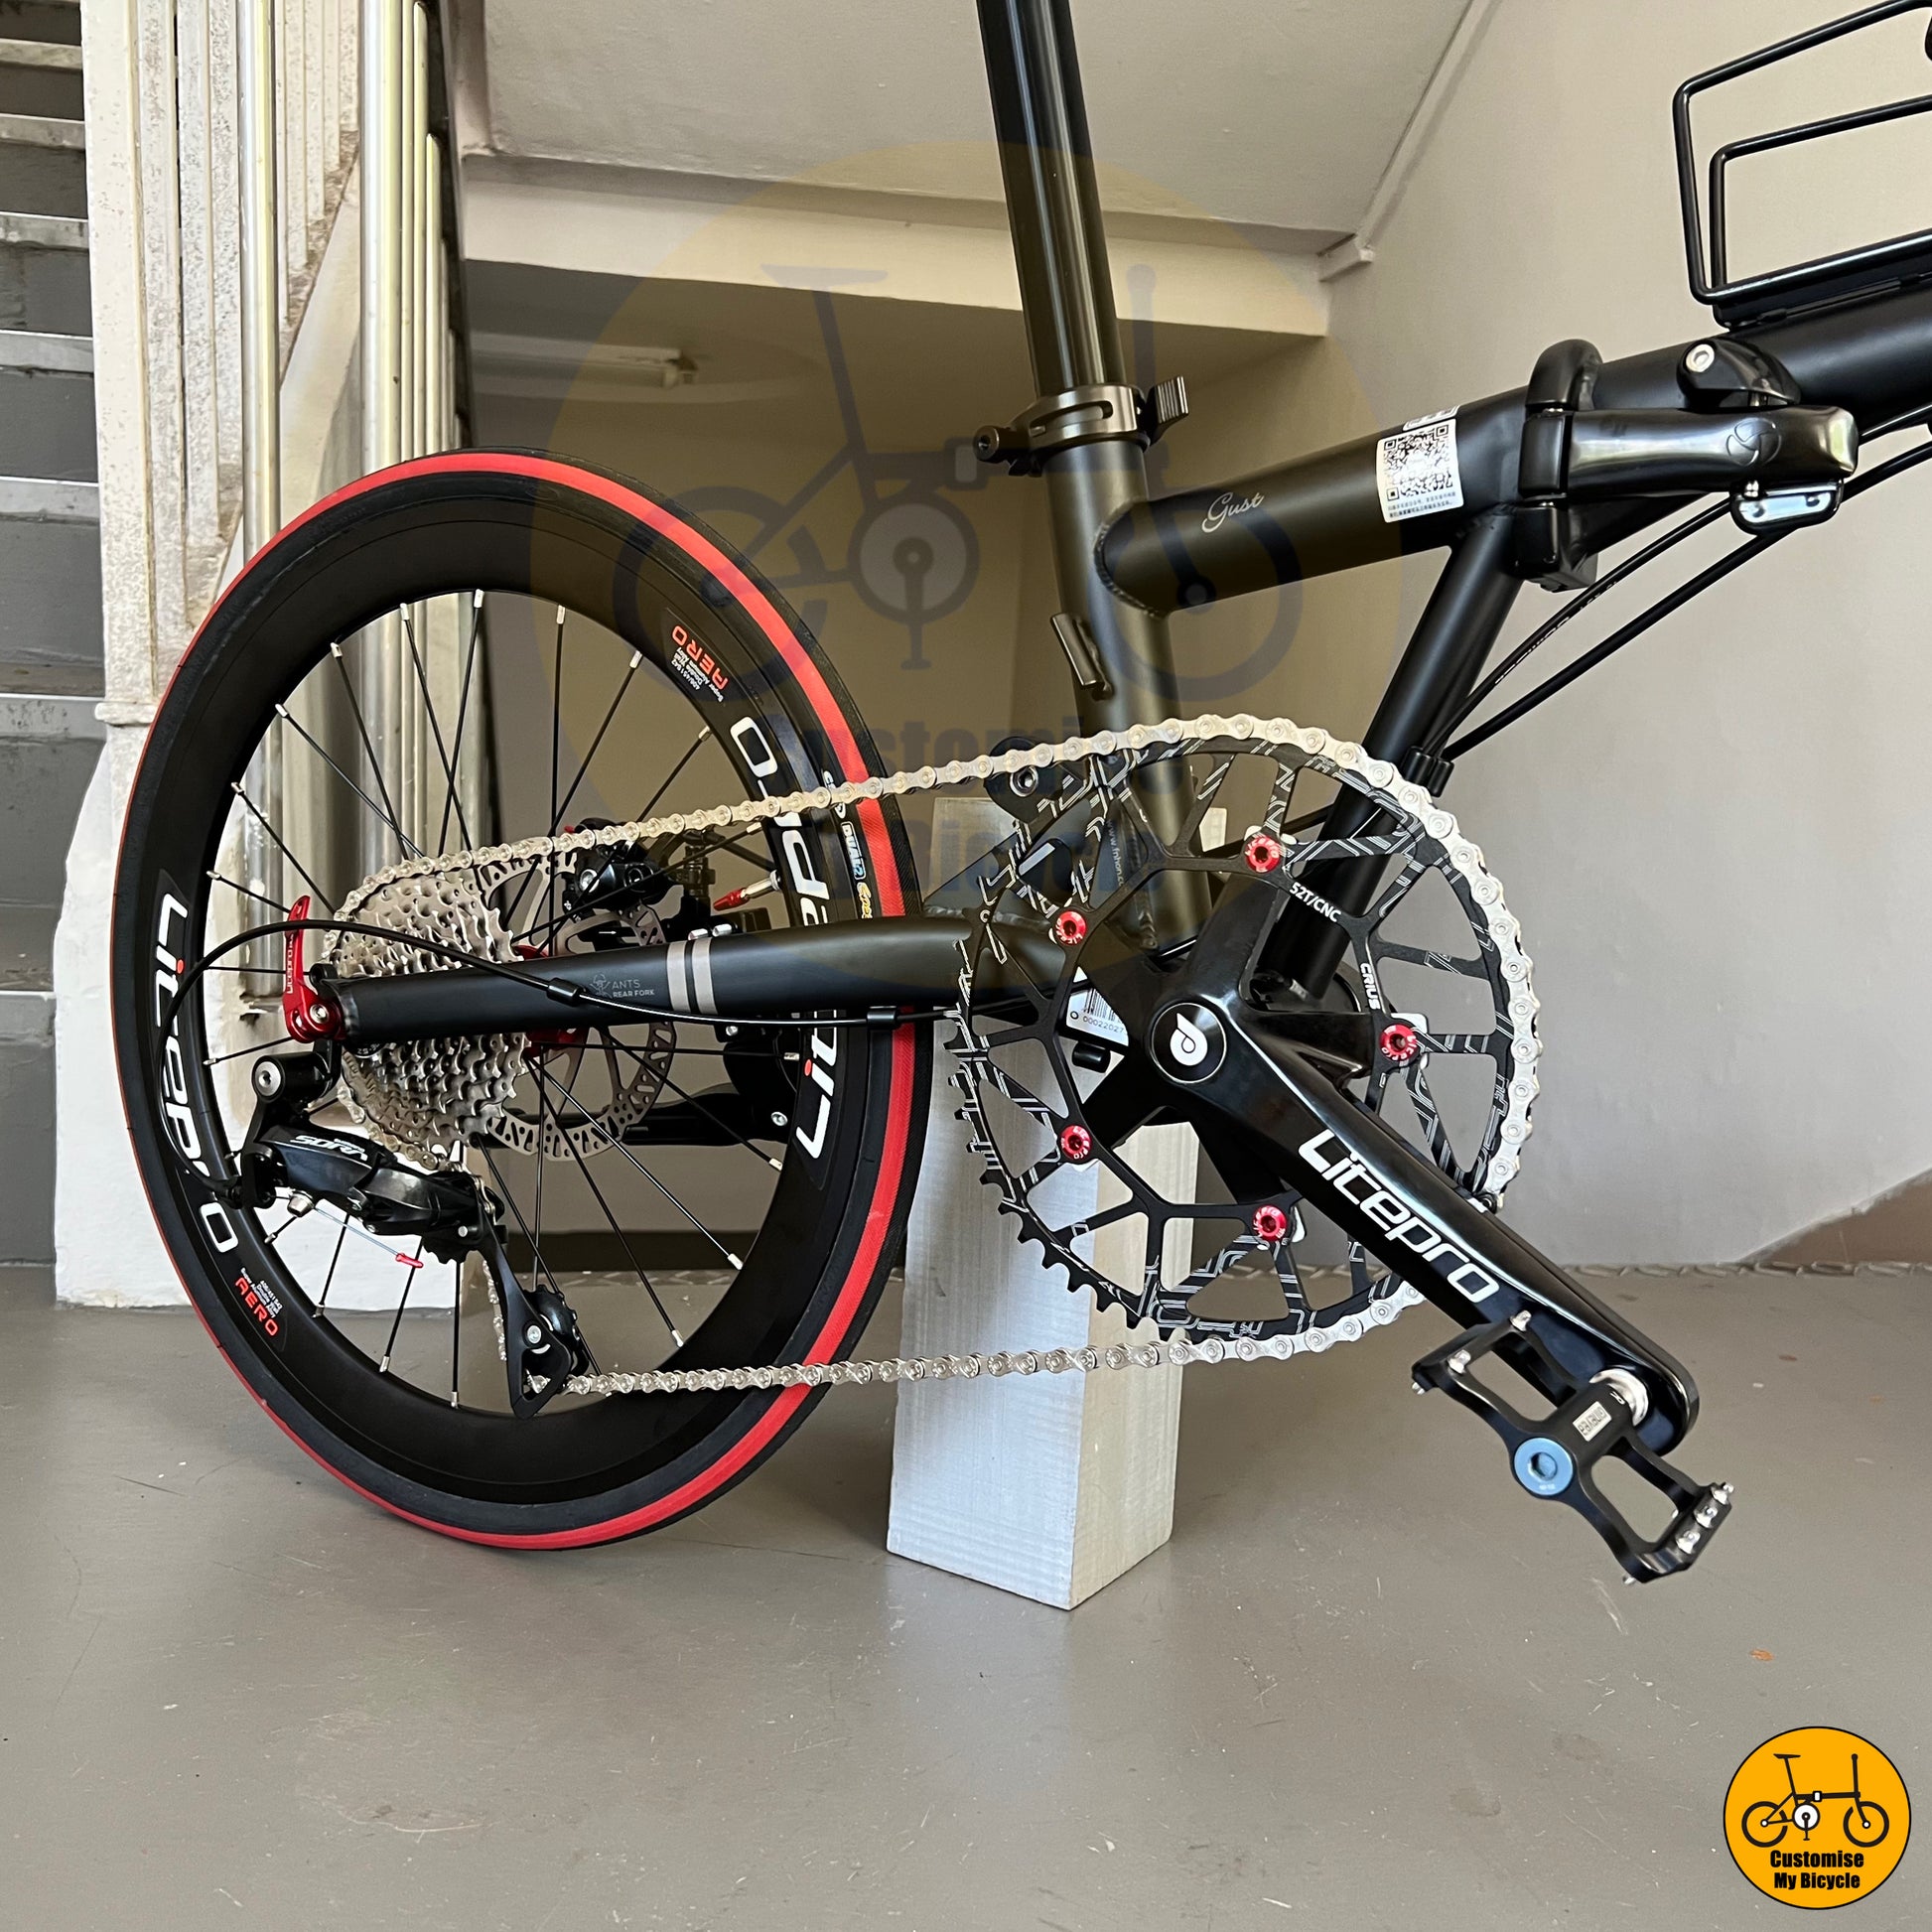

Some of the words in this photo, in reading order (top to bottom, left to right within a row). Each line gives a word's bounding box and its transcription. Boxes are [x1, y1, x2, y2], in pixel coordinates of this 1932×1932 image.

[1202, 491, 1264, 533] Gust
[672, 625, 729, 690] AERO
[1289, 882, 1341, 922] 52T/CNC
[612, 978, 640, 990] ANTS
[613, 989, 633, 998] REAR
[634, 988, 655, 997] FORK
[1359, 962, 1382, 1010] CRIUS
[290, 1135, 368, 1162] SORA
[1299, 1129, 1500, 1304] Litepro
[235, 1277, 278, 1336] AERO
